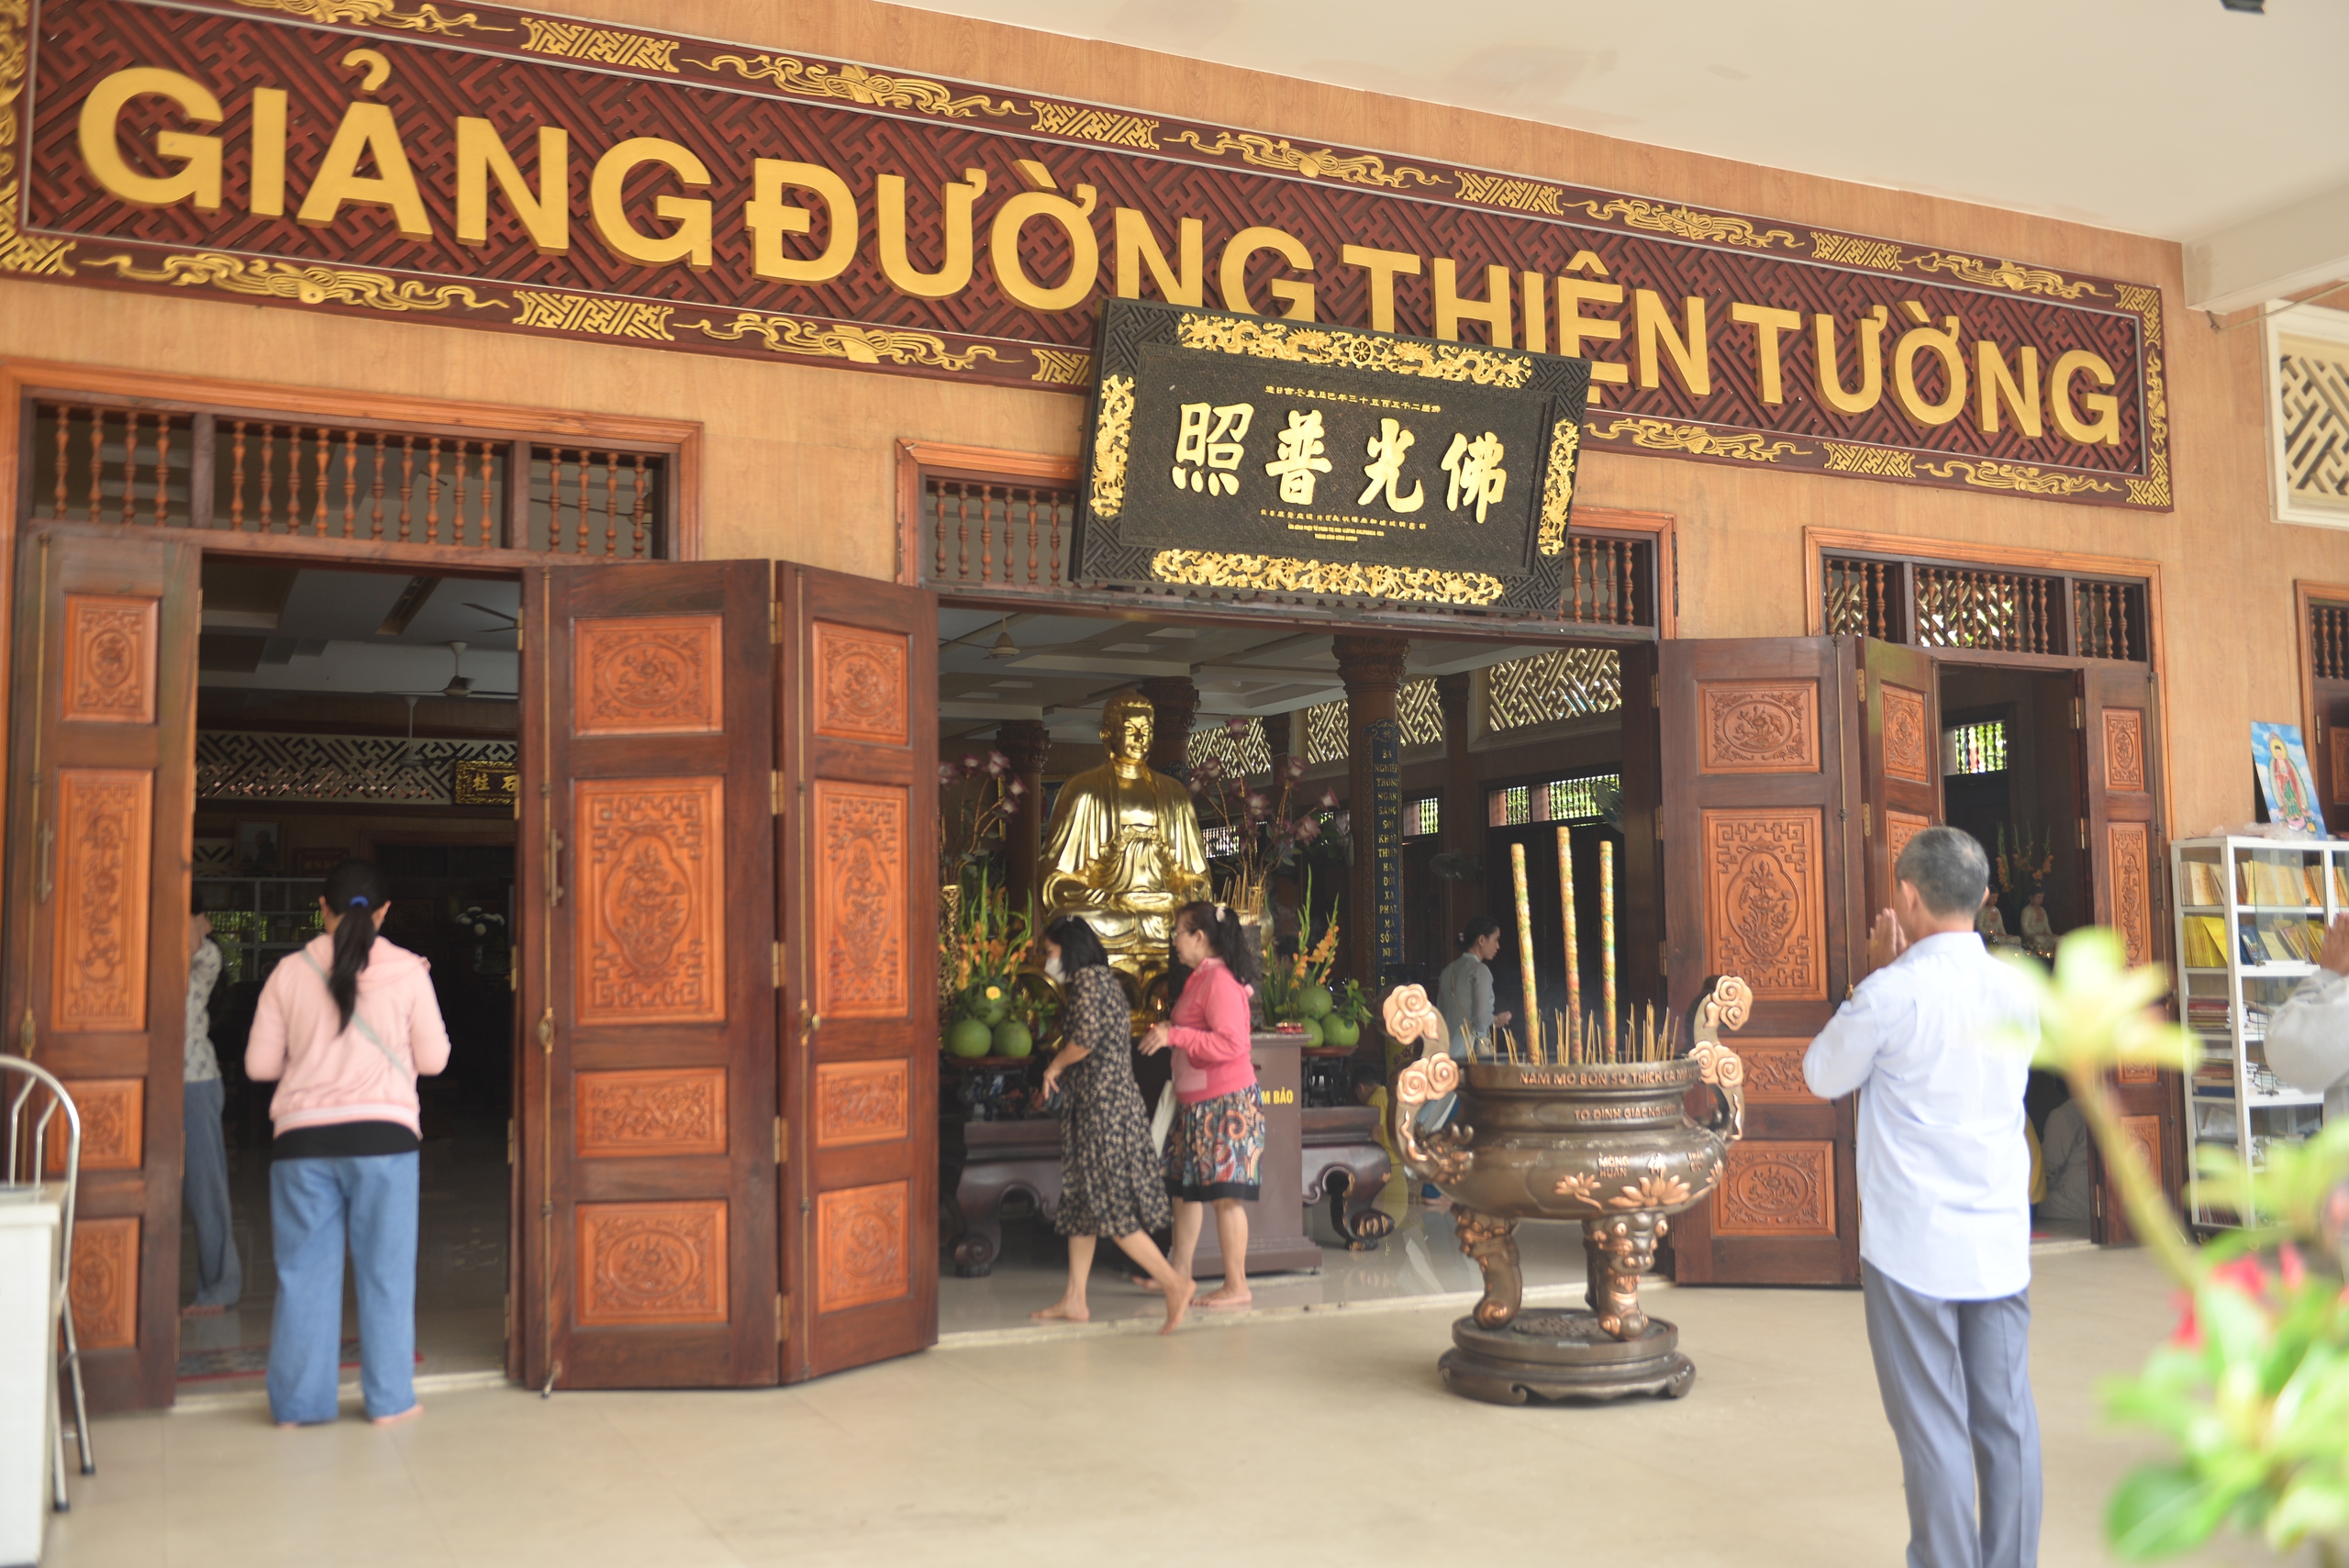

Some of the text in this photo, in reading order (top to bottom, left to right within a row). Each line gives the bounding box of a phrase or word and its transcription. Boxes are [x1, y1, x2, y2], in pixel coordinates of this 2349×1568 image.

[77, 49, 2121, 447] GIẢNG ĐƯỜNG THIỆN TƯỜNG
[1382, 749, 1393, 759] BA
[1384, 890, 1395, 900] XA
[1520, 1072, 1551, 1085] NAM
[1553, 1070, 1577, 1085] MÔ
[1664, 1070, 1675, 1082] CA
[1273, 1085, 1294, 1105] BẢO
